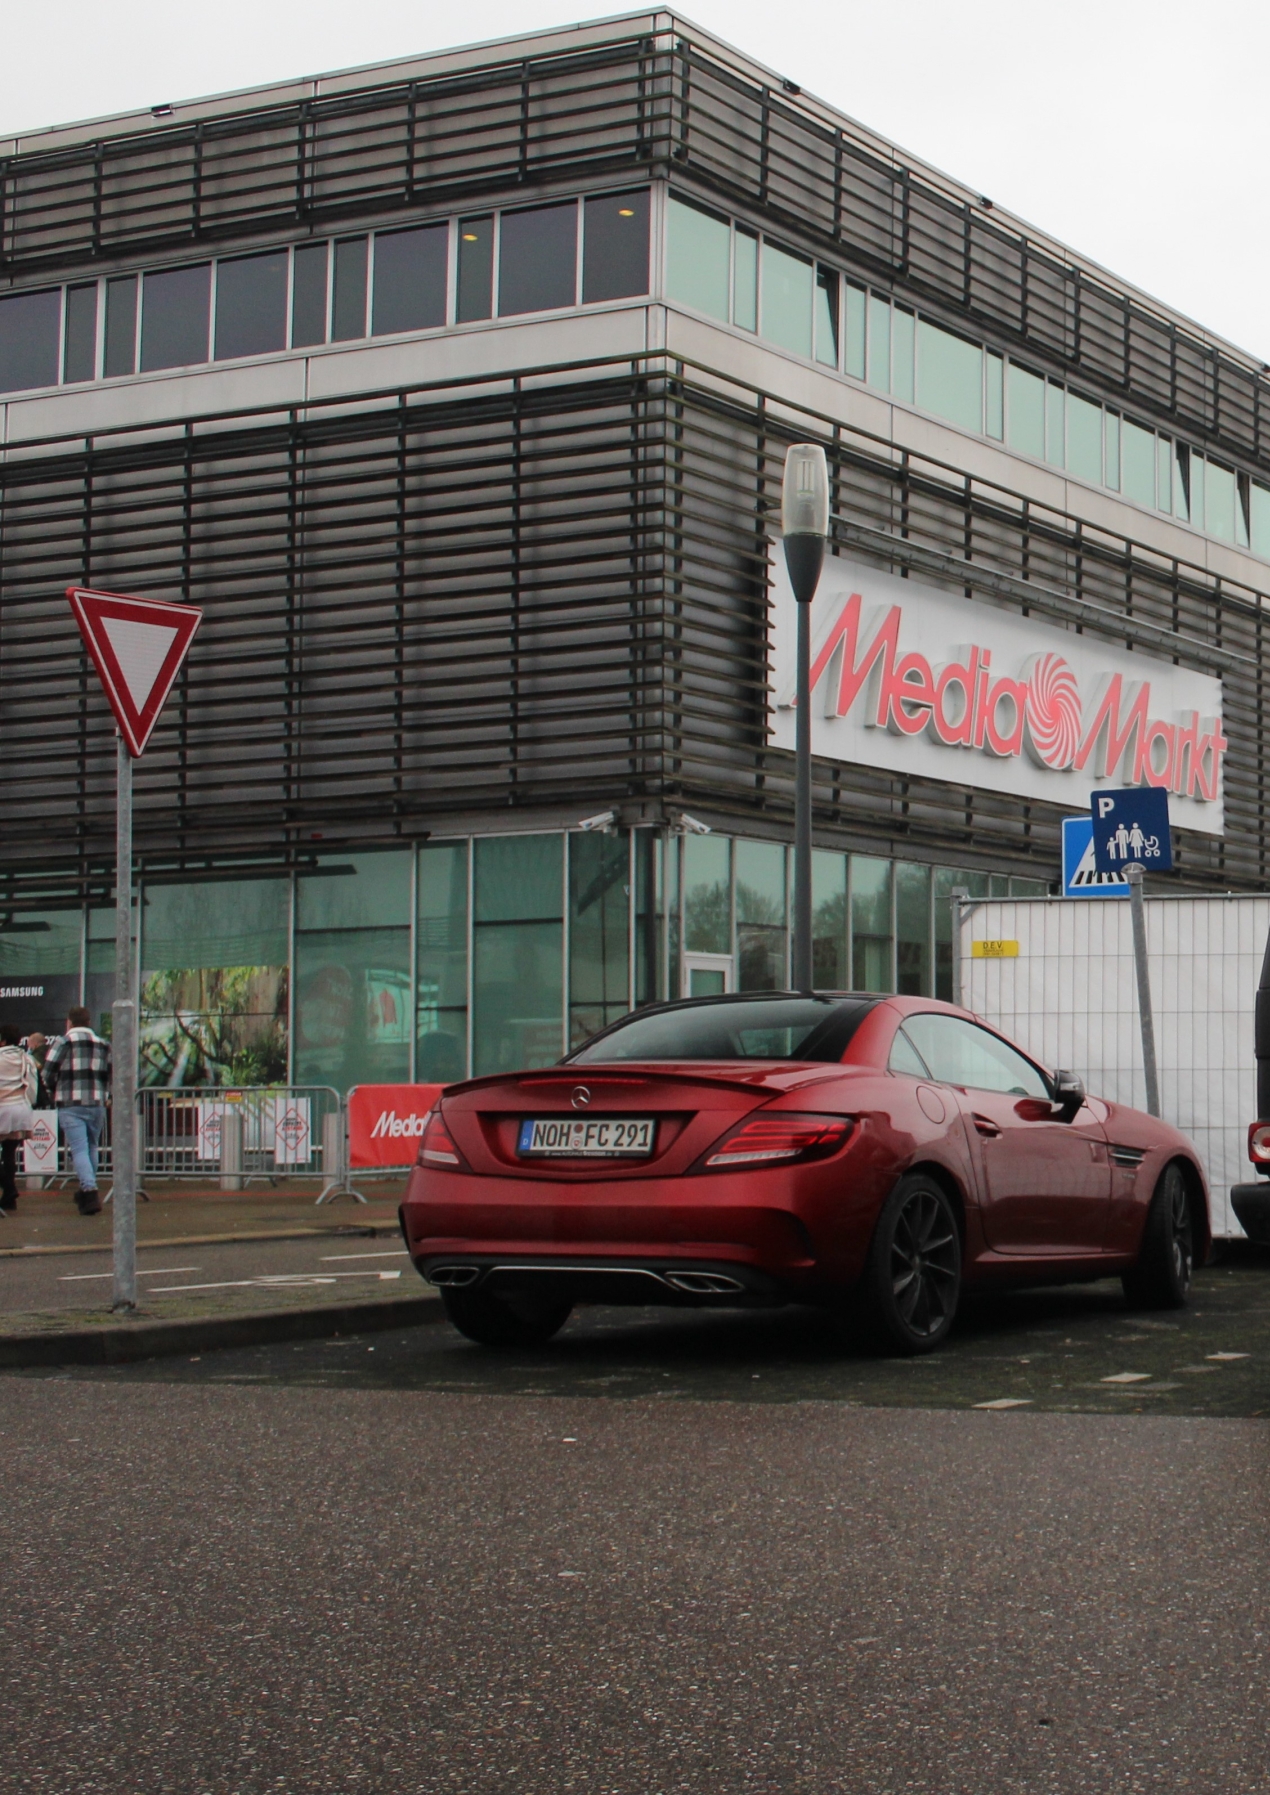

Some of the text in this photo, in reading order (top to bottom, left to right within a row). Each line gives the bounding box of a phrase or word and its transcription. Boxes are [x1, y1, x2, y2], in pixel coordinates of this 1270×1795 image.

[791, 592, 1228, 802] Media Markt
[1098, 797, 1115, 819] P
[0, 986, 44, 998] SAMSUNG
[522, 1138, 529, 1146] D
[532, 1122, 650, 1148] NOH FC 291
